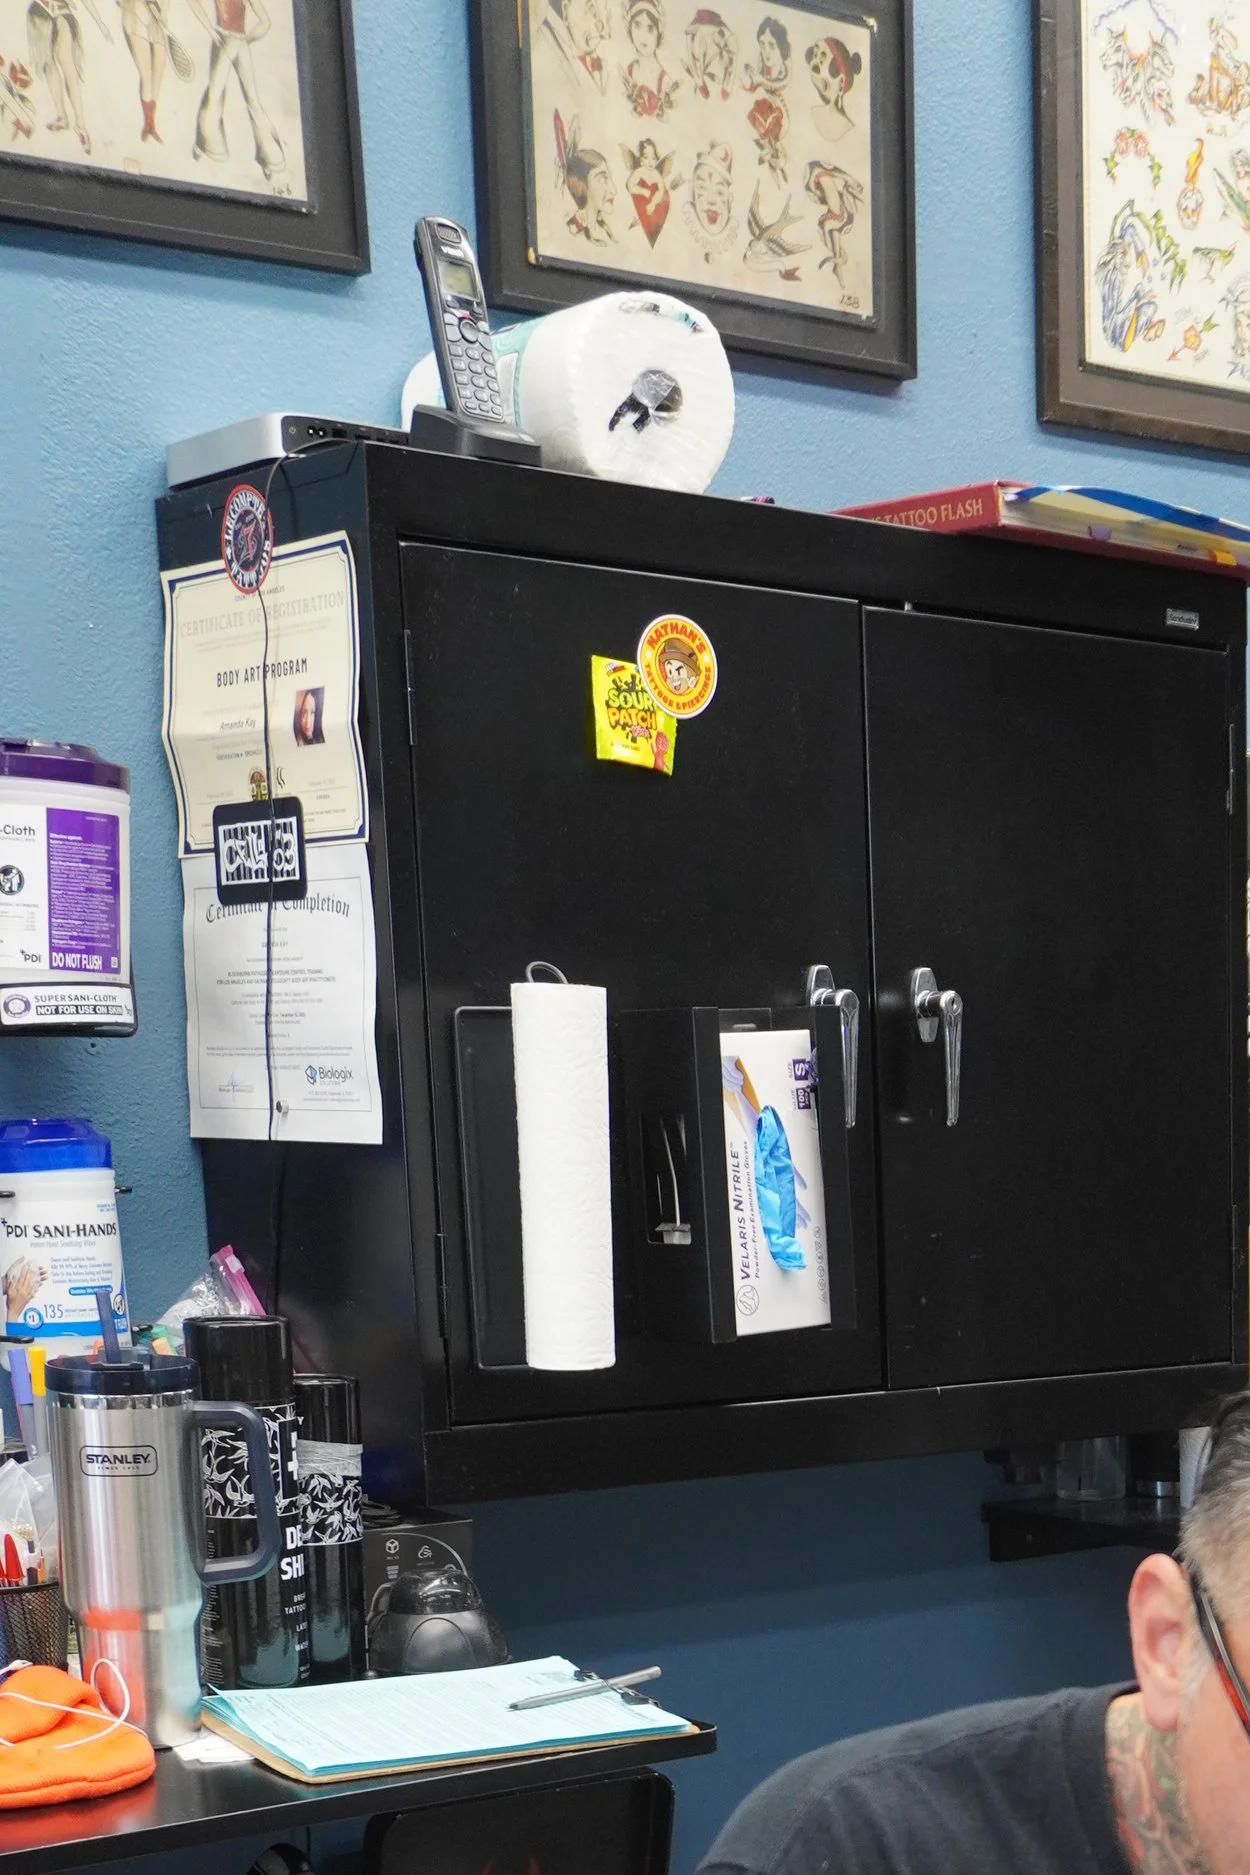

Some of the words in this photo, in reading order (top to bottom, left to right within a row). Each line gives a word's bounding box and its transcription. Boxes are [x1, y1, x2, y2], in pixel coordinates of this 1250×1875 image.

[885, 506, 938, 527] TATTOO
[940, 498, 984, 522] FLASH
[180, 611, 245, 639] CERTIFICATE
[266, 590, 345, 621] REGISTRATION
[646, 621, 707, 655] NATHAN'S
[216, 669, 240, 688] BODY
[244, 665, 260, 684] ART
[265, 657, 308, 679] PROGRAM
[644, 663, 675, 708] TATTOOS
[608, 689, 658, 711] SOUR
[220, 719, 245, 731] Amanda
[245, 717, 257, 730] Kay
[607, 707, 658, 730] PATCH
[24, 953, 42, 964] PDI
[52, 952, 63, 968] DO
[65, 952, 81, 969] NOT
[82, 953, 103, 971] FLUSH
[34, 994, 66, 1003] SUPER
[68, 994, 117, 1003] SANI-CLOTH
[37, 1005, 57, 1016] NOT
[59, 1005, 76, 1015] FOR
[78, 1005, 95, 1015] USE
[97, 1005, 108, 1015] ON
[109, 1005, 123, 1014] SKIN
[318, 1065, 353, 1086] Biologix
[794, 1062, 806, 1077] S
[797, 1089, 806, 1108] 100
[743, 1140, 751, 1170] Gloves
[730, 1150, 745, 1212] NITRILE
[745, 1170, 757, 1223] Examination
[6, 1224, 27, 1239] PDI
[33, 1222, 117, 1239] SANI-HANDS
[738, 1216, 751, 1281] VELARIS
[750, 1223, 761, 1279] Powder-Free
[43, 1303, 64, 1319] 135
[86, 1453, 150, 1464] STANLEY
